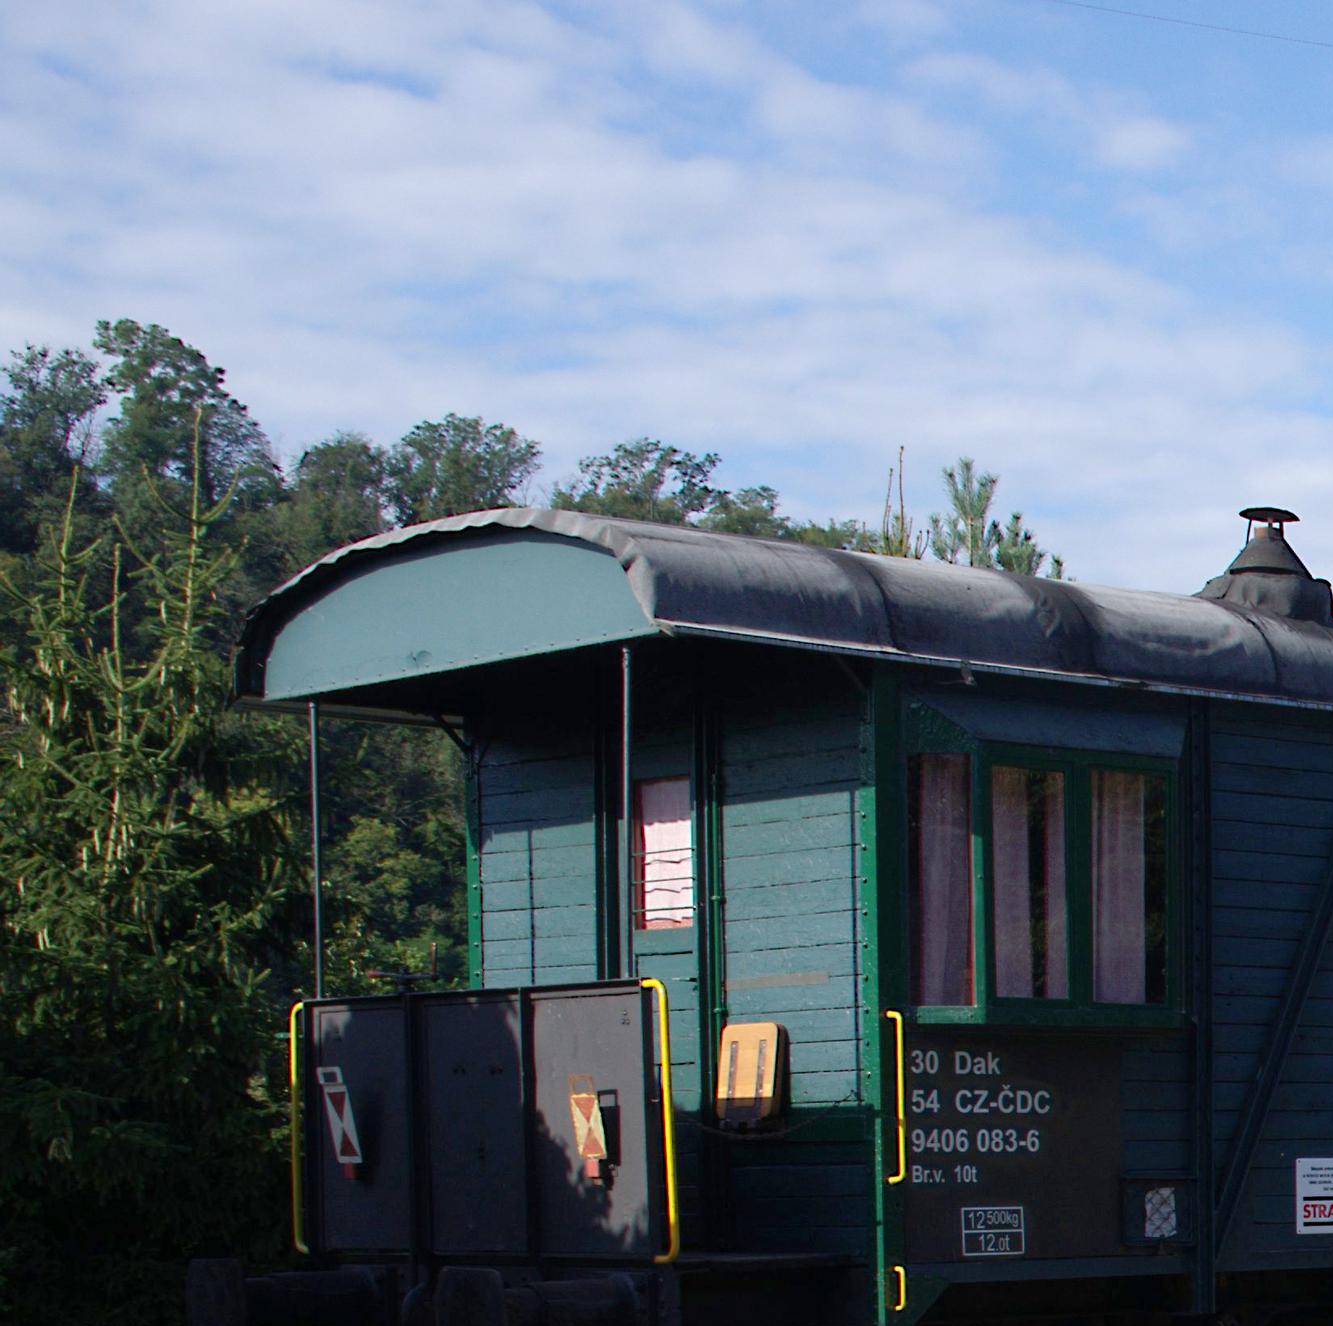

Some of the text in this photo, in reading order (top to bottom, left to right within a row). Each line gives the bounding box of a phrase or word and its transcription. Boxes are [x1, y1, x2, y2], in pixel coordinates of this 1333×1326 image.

[910, 1050, 1001, 1075] 30 Dak
[911, 1084, 1051, 1114] 54 CZ-ČDC
[911, 1129, 1040, 1153] 9406 083-6
[911, 1165, 978, 1183] Br.v. 10t
